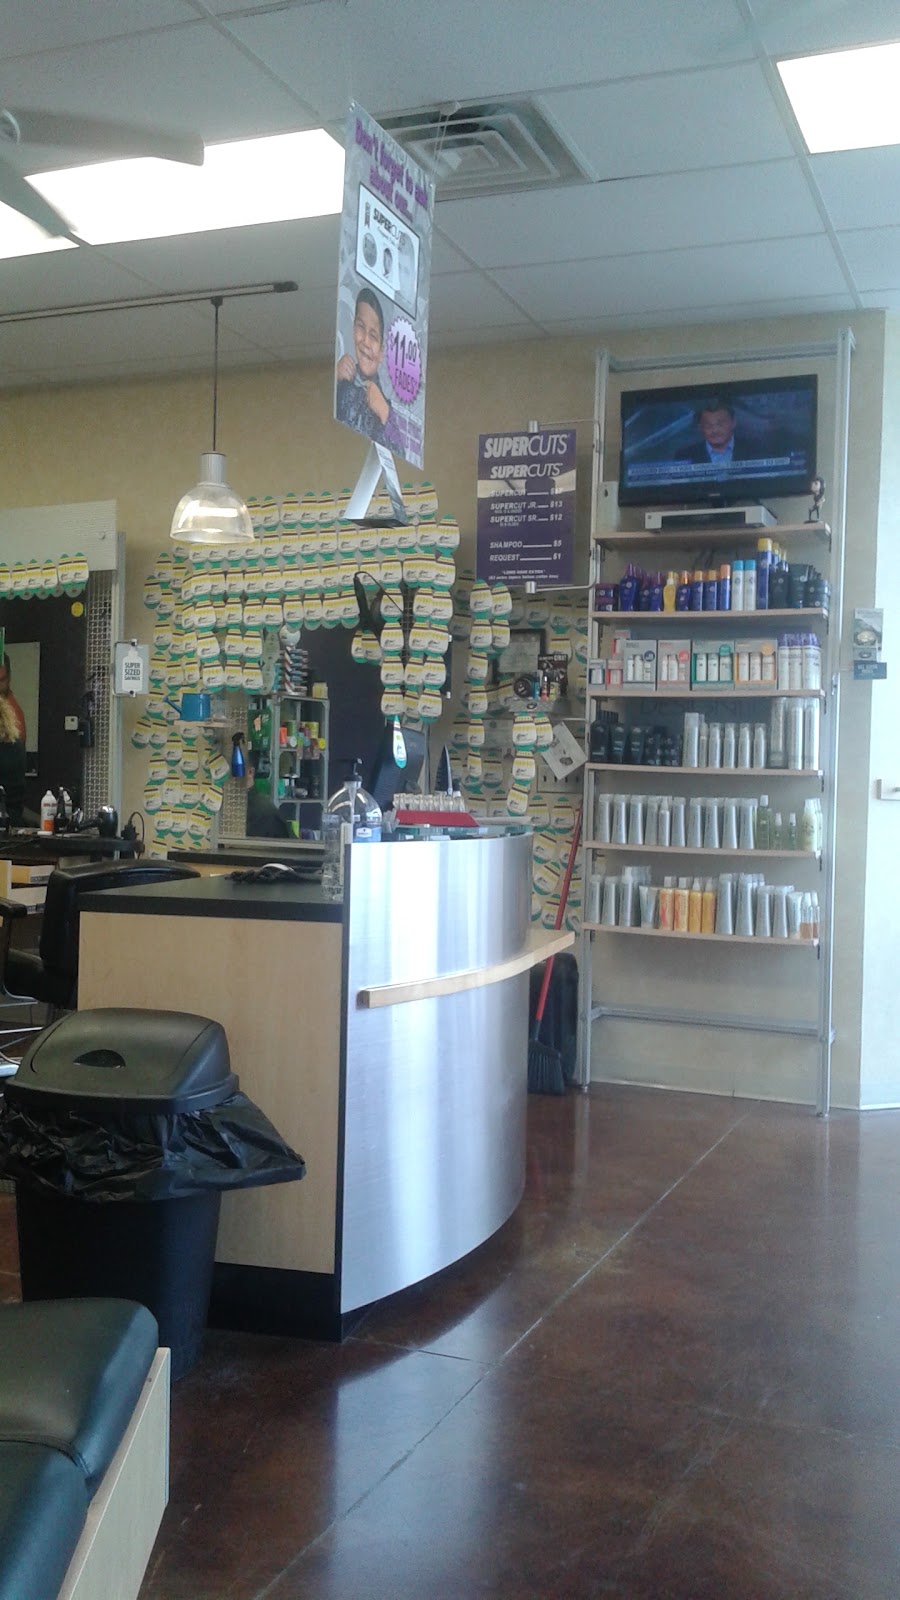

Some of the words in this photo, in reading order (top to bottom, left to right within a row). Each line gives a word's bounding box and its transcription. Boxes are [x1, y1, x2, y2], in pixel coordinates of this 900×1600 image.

[484, 433, 568, 459] SUPERCUTS
[490, 463, 562, 479] SUPERCUTS
[490, 502, 527, 510] SUPERCUT
[490, 515, 526, 523] SUPERCUT
[490, 541, 523, 549] SHAMPOO
